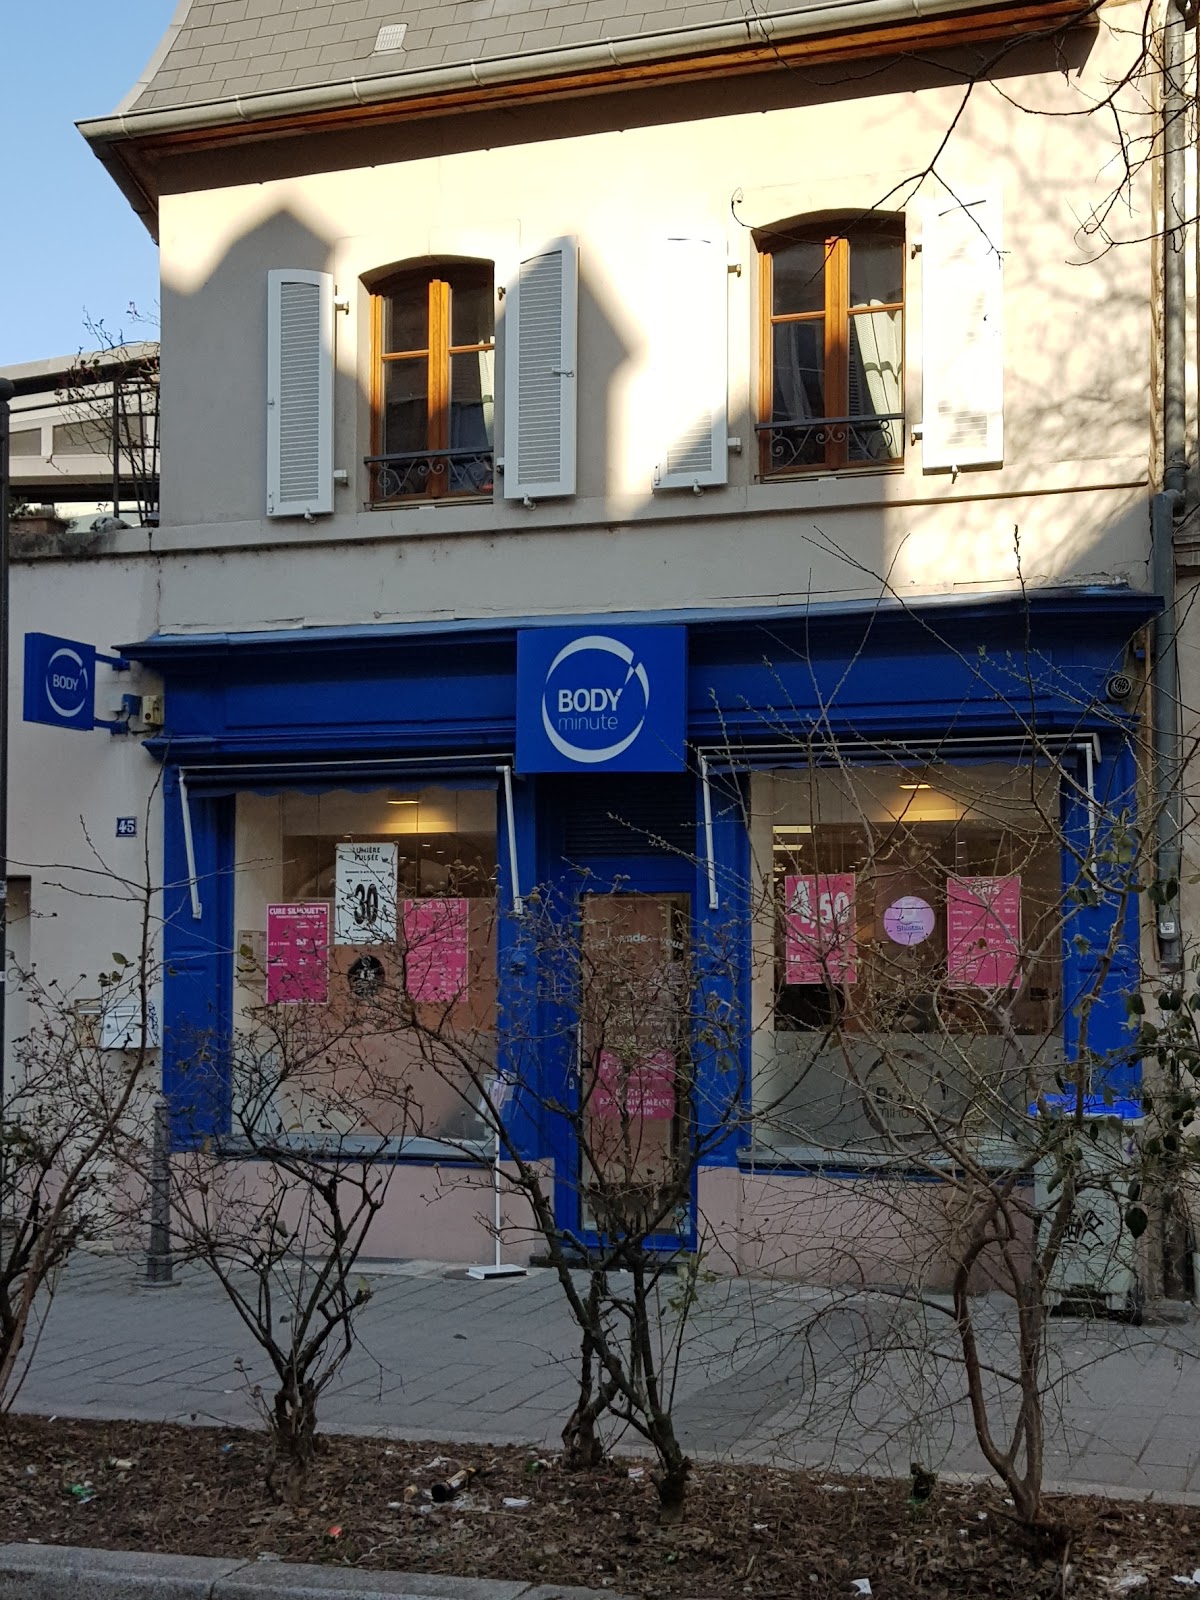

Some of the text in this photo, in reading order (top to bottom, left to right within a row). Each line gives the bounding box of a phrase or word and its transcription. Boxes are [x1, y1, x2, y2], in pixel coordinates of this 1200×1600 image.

[53, 674, 79, 691] BODY
[558, 688, 623, 713] BODY
[558, 714, 619, 731] minute
[118, 820, 135, 833] 45
[269, 907, 286, 915] CURE
[353, 883, 379, 925] 30
